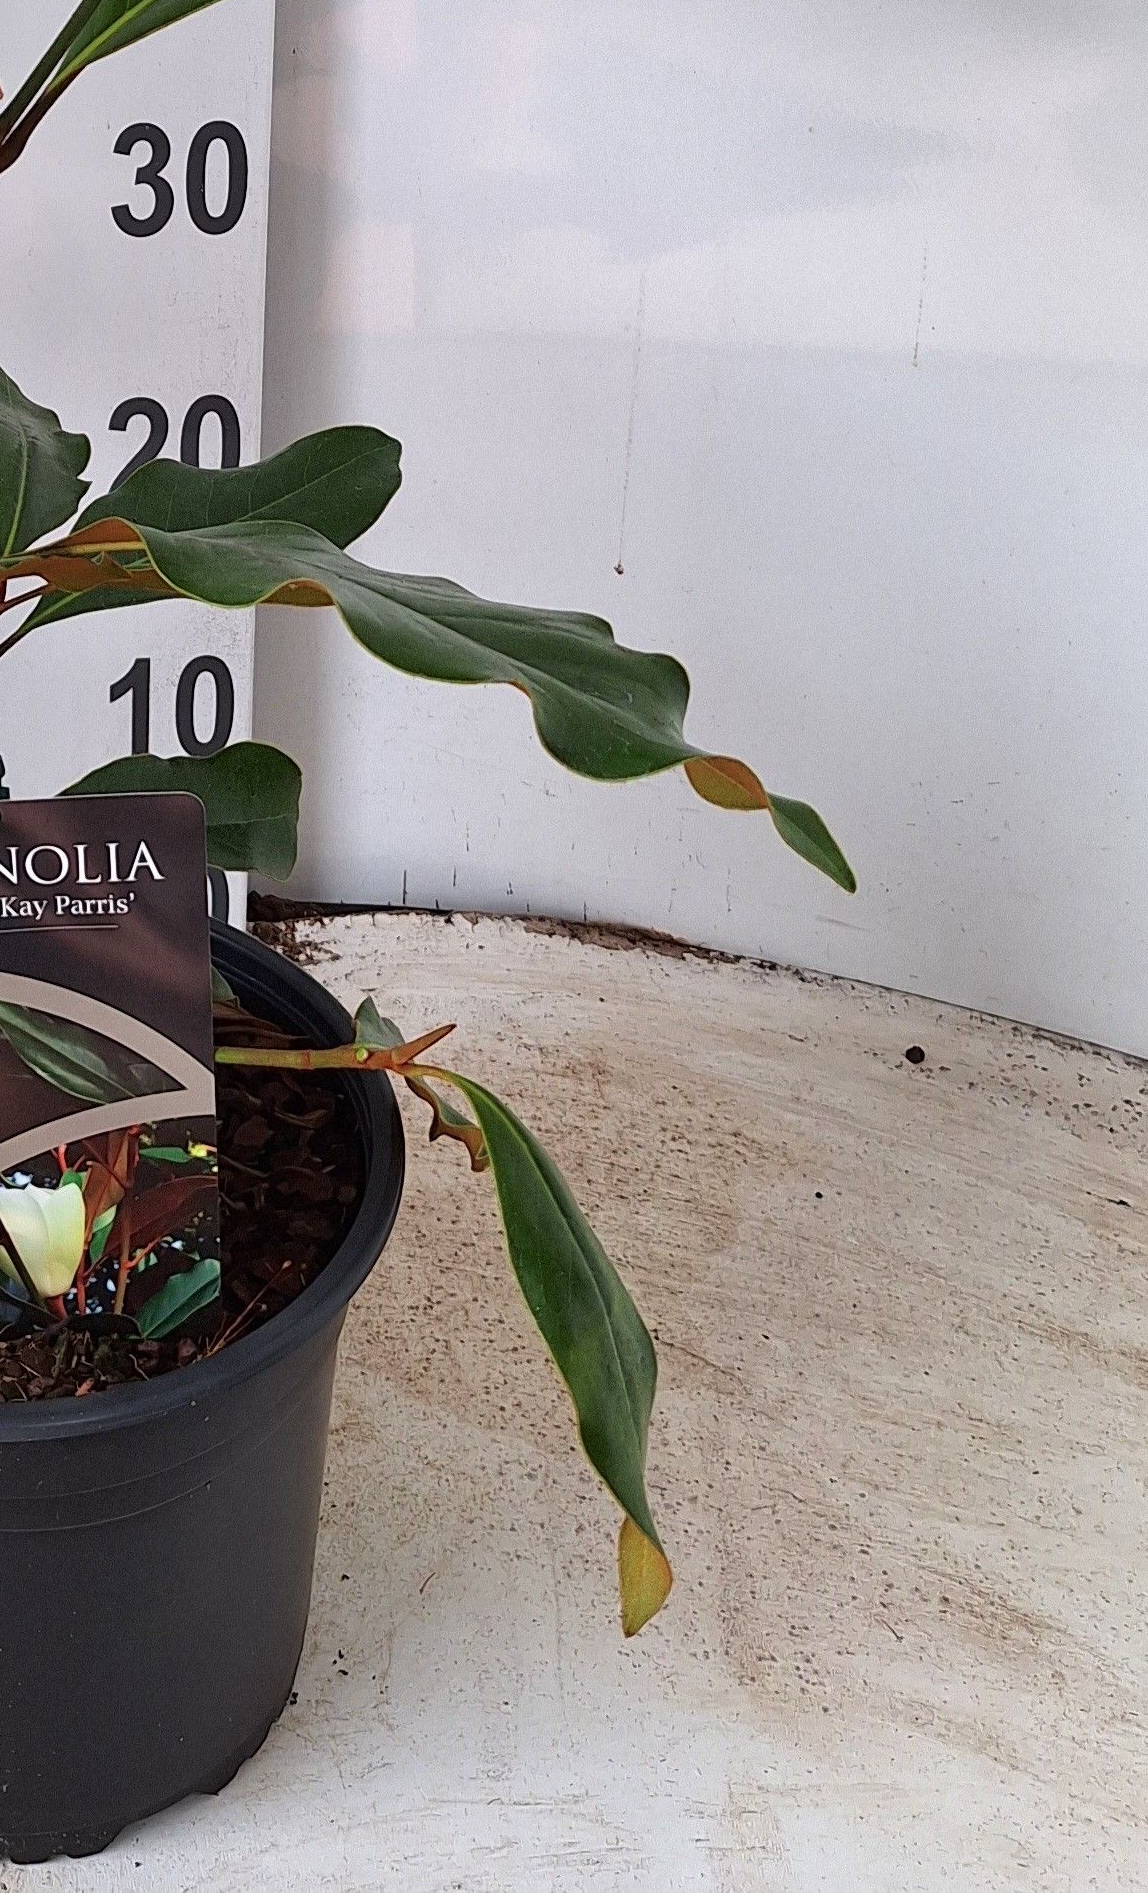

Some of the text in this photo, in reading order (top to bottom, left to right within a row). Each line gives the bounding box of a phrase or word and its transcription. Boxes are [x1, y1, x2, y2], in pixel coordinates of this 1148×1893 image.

[110, 120, 248, 238] 30
[108, 394, 241, 494] 20
[109, 654, 235, 757] 10
[55, 892, 136, 916] Parris’
